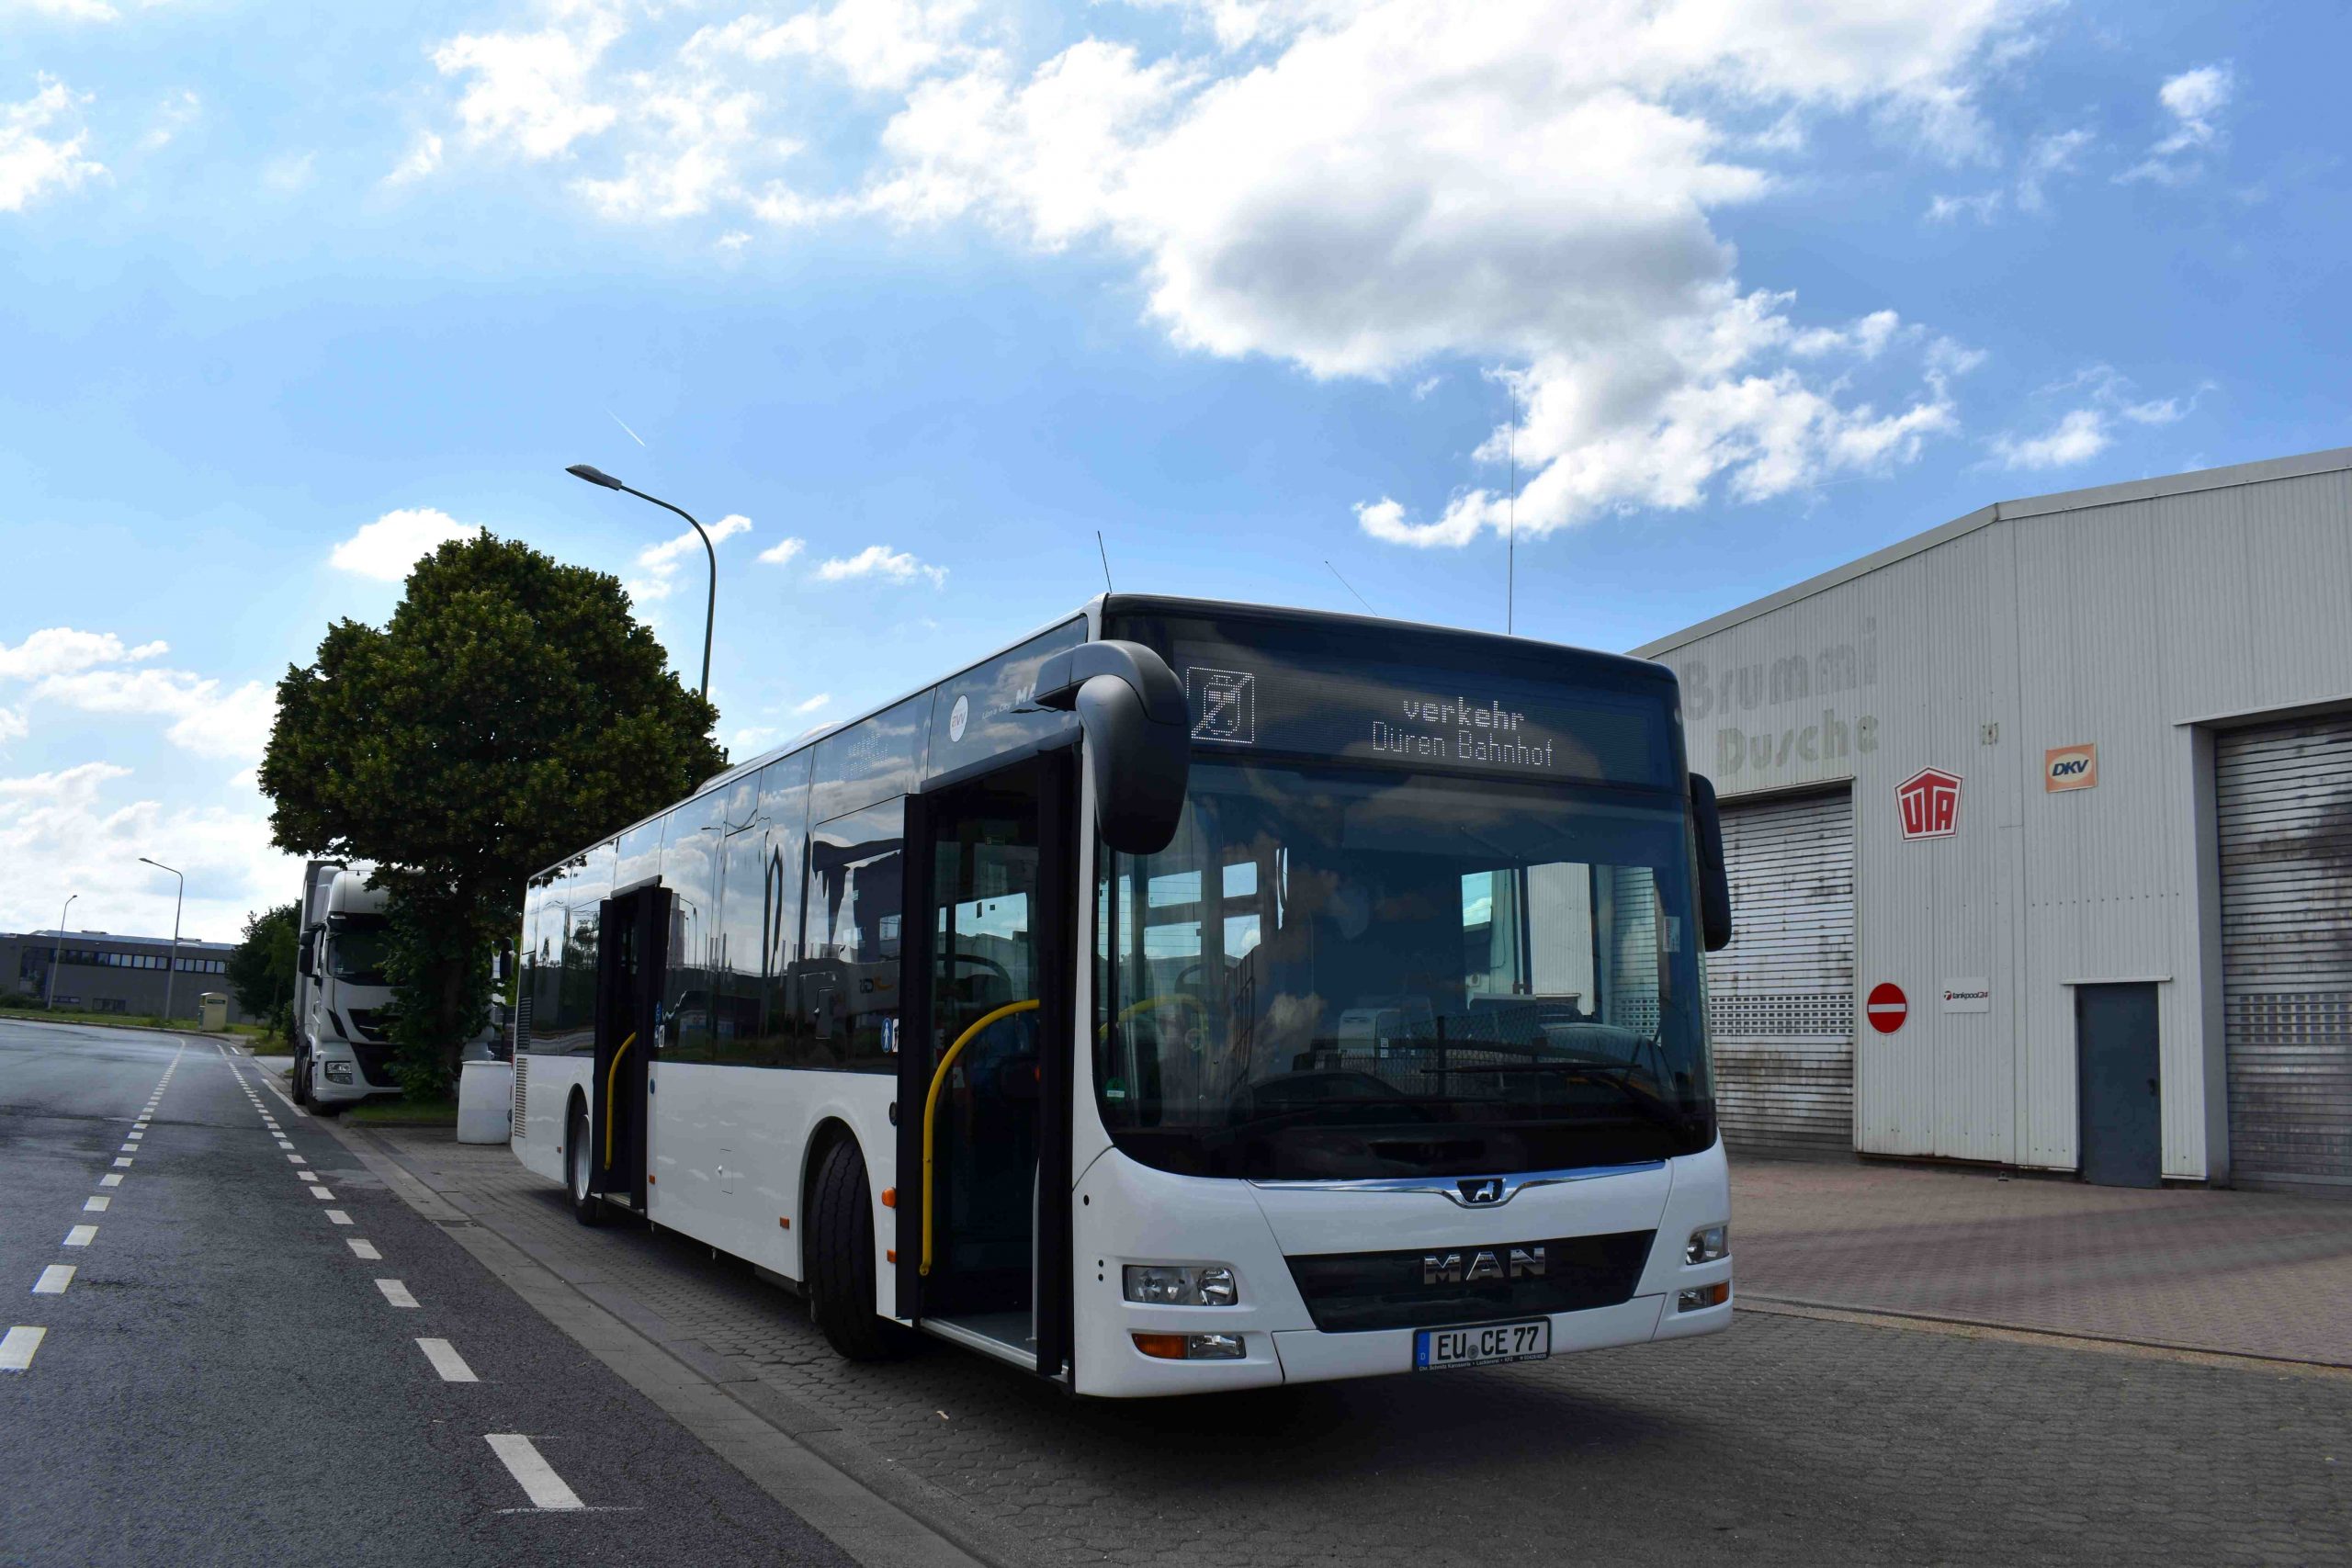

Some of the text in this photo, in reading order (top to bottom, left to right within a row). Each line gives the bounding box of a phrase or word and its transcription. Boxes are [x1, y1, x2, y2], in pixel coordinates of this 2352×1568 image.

[1680, 616, 1877, 721] Brummi
[1015, 682, 1036, 706] MA
[1403, 696, 1524, 729] verkehr
[1373, 721, 1553, 766] Düren Bahnhof
[1717, 708, 1878, 776] Dusche
[2052, 759, 2089, 776] DKV
[1900, 773, 1957, 834] UTA
[1424, 1247, 1545, 1284] MAN
[1438, 1326, 1539, 1360] EU CE 77
